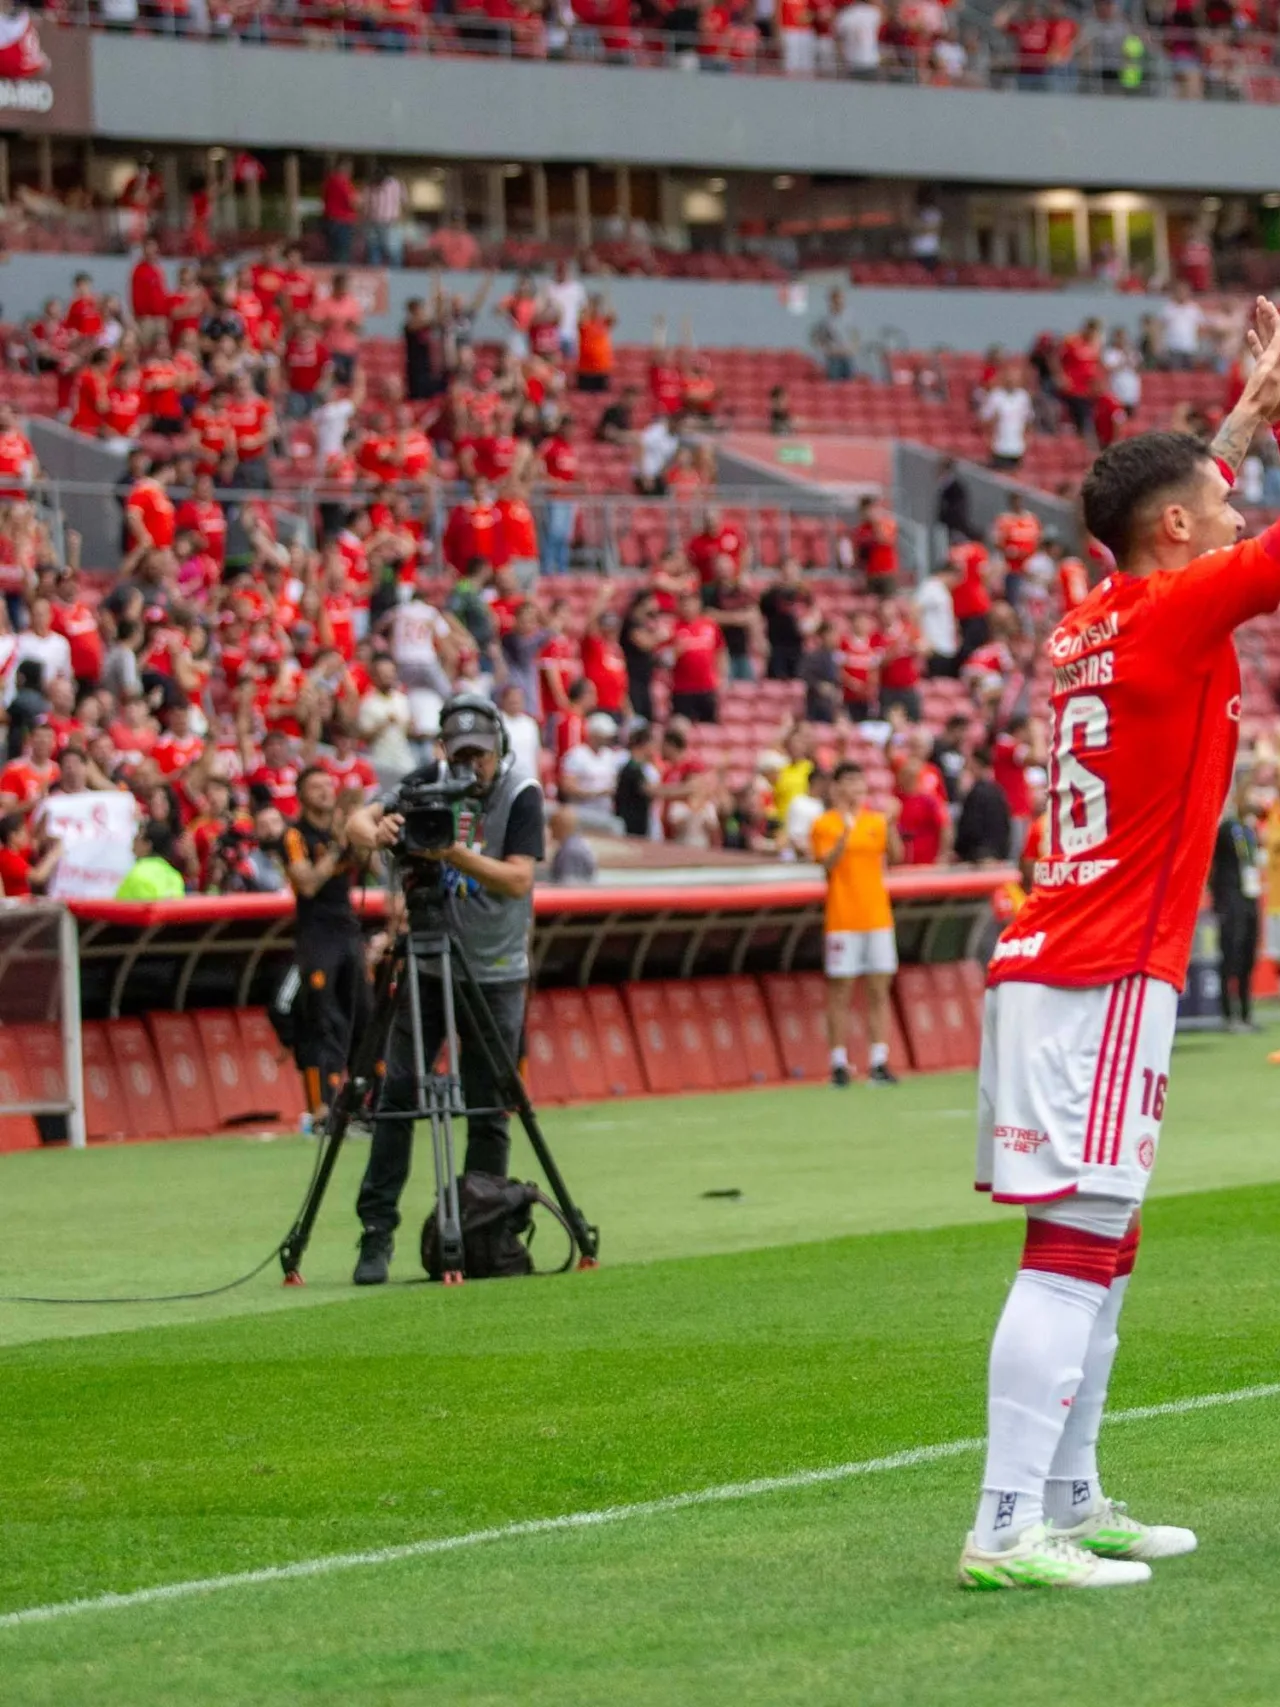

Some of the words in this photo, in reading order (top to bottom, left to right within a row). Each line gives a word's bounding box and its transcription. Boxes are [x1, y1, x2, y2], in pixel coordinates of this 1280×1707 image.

[1141, 1067, 1169, 1121] 16
[994, 1125, 1049, 1144] ESTRELA
[1014, 1140, 1041, 1154] BET
